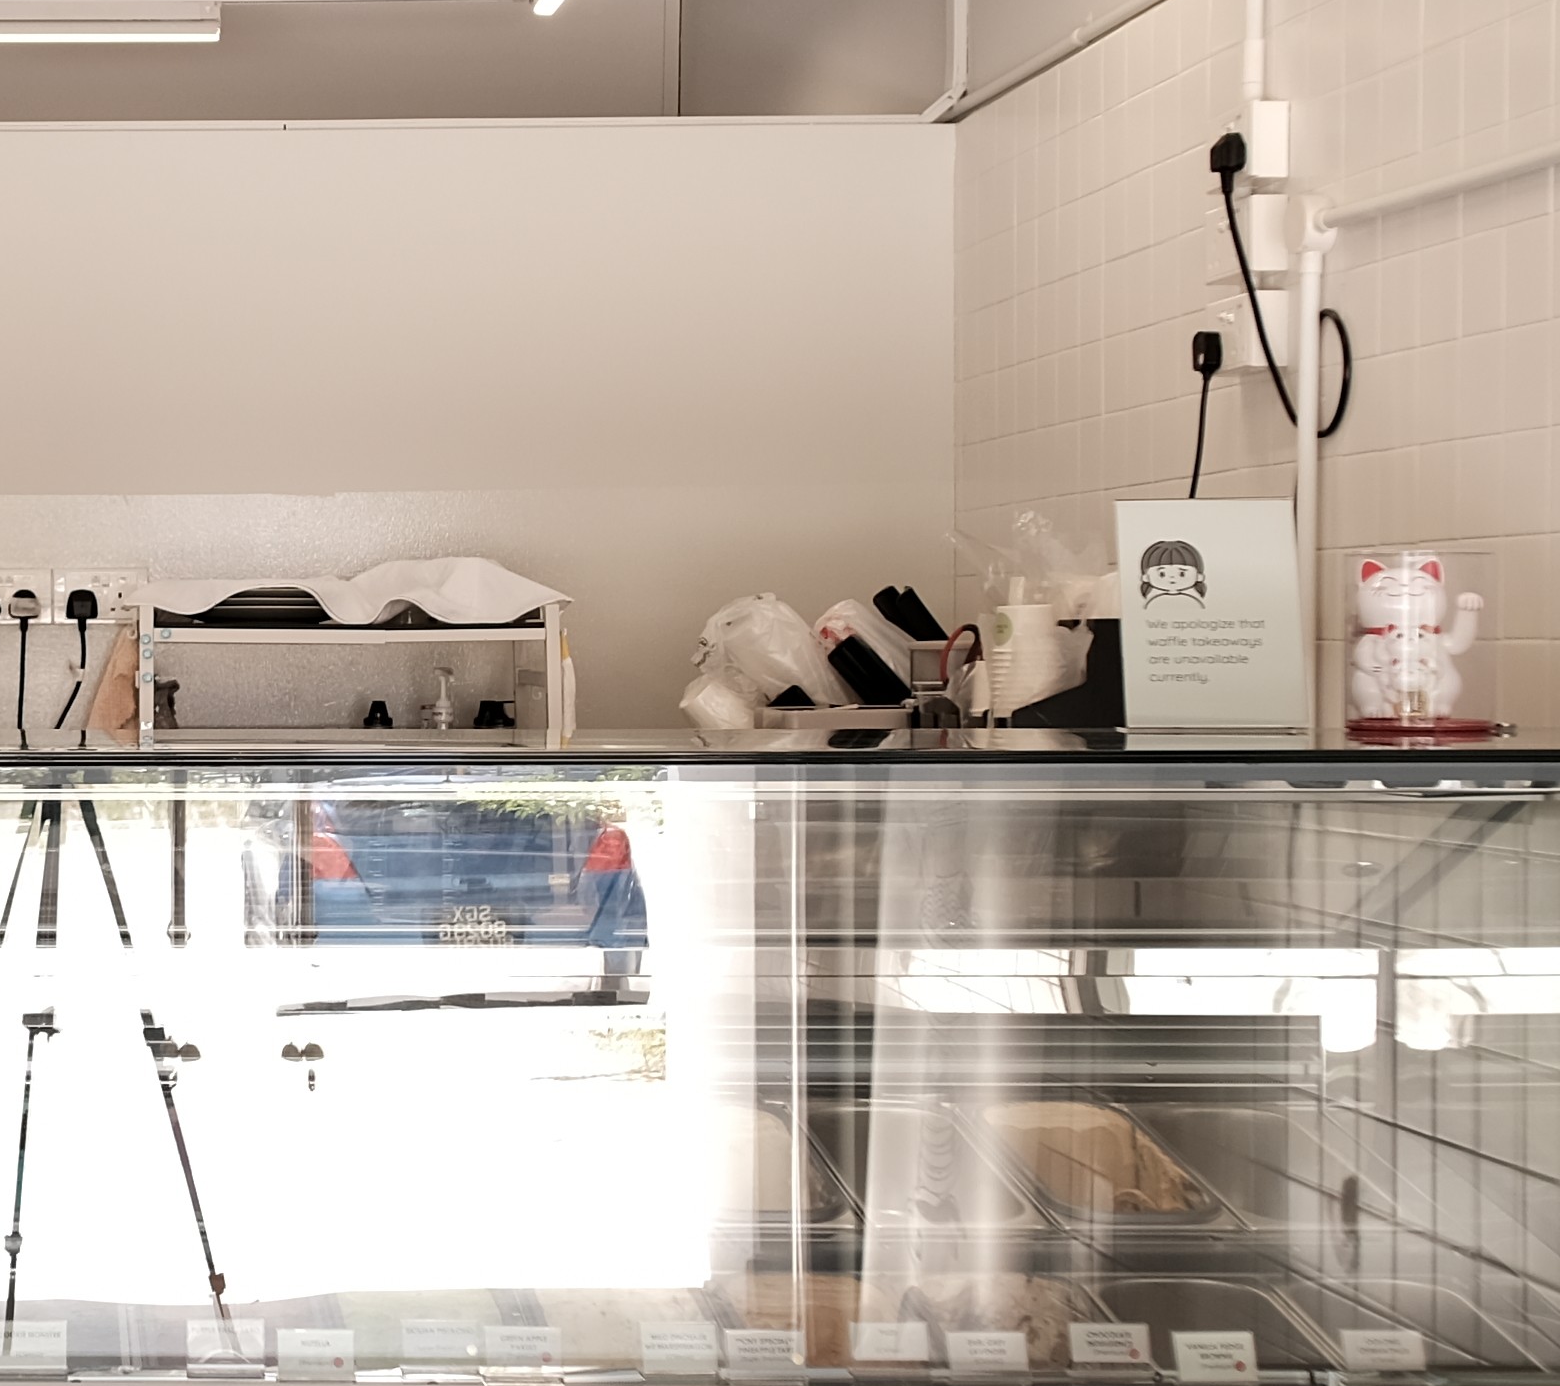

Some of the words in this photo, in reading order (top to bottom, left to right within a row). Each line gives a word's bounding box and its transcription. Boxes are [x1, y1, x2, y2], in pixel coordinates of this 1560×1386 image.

[1146, 619, 1168, 629] We
[1171, 619, 1235, 631] apologize
[1238, 619, 1266, 629] that
[1147, 636, 1188, 647] waffle
[1191, 636, 1264, 649] takeaways
[1148, 655, 1170, 664] are
[1174, 654, 1250, 664] unavailable
[1148, 672, 1211, 685] currently.
[300, 1339, 331, 1347] NUTELLA
